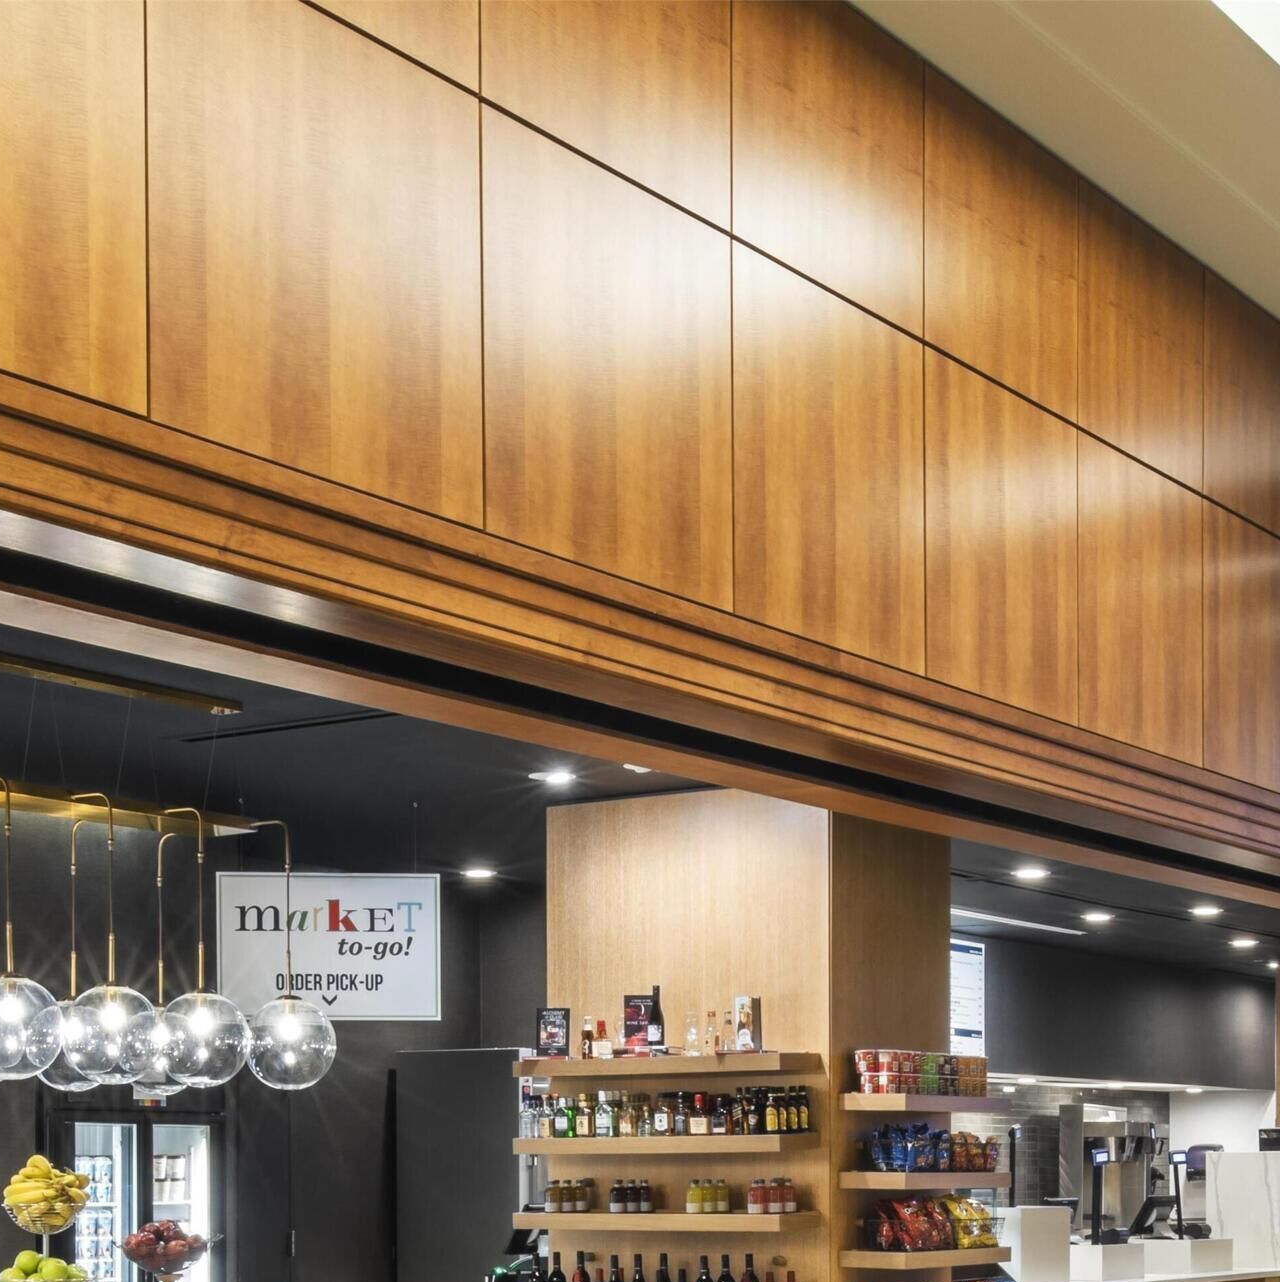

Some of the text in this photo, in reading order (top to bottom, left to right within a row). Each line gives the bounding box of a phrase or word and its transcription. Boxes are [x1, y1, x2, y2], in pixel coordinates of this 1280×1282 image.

[338, 936, 413, 960] to-go!
[276, 973, 383, 991] ORDER PICK-UP
